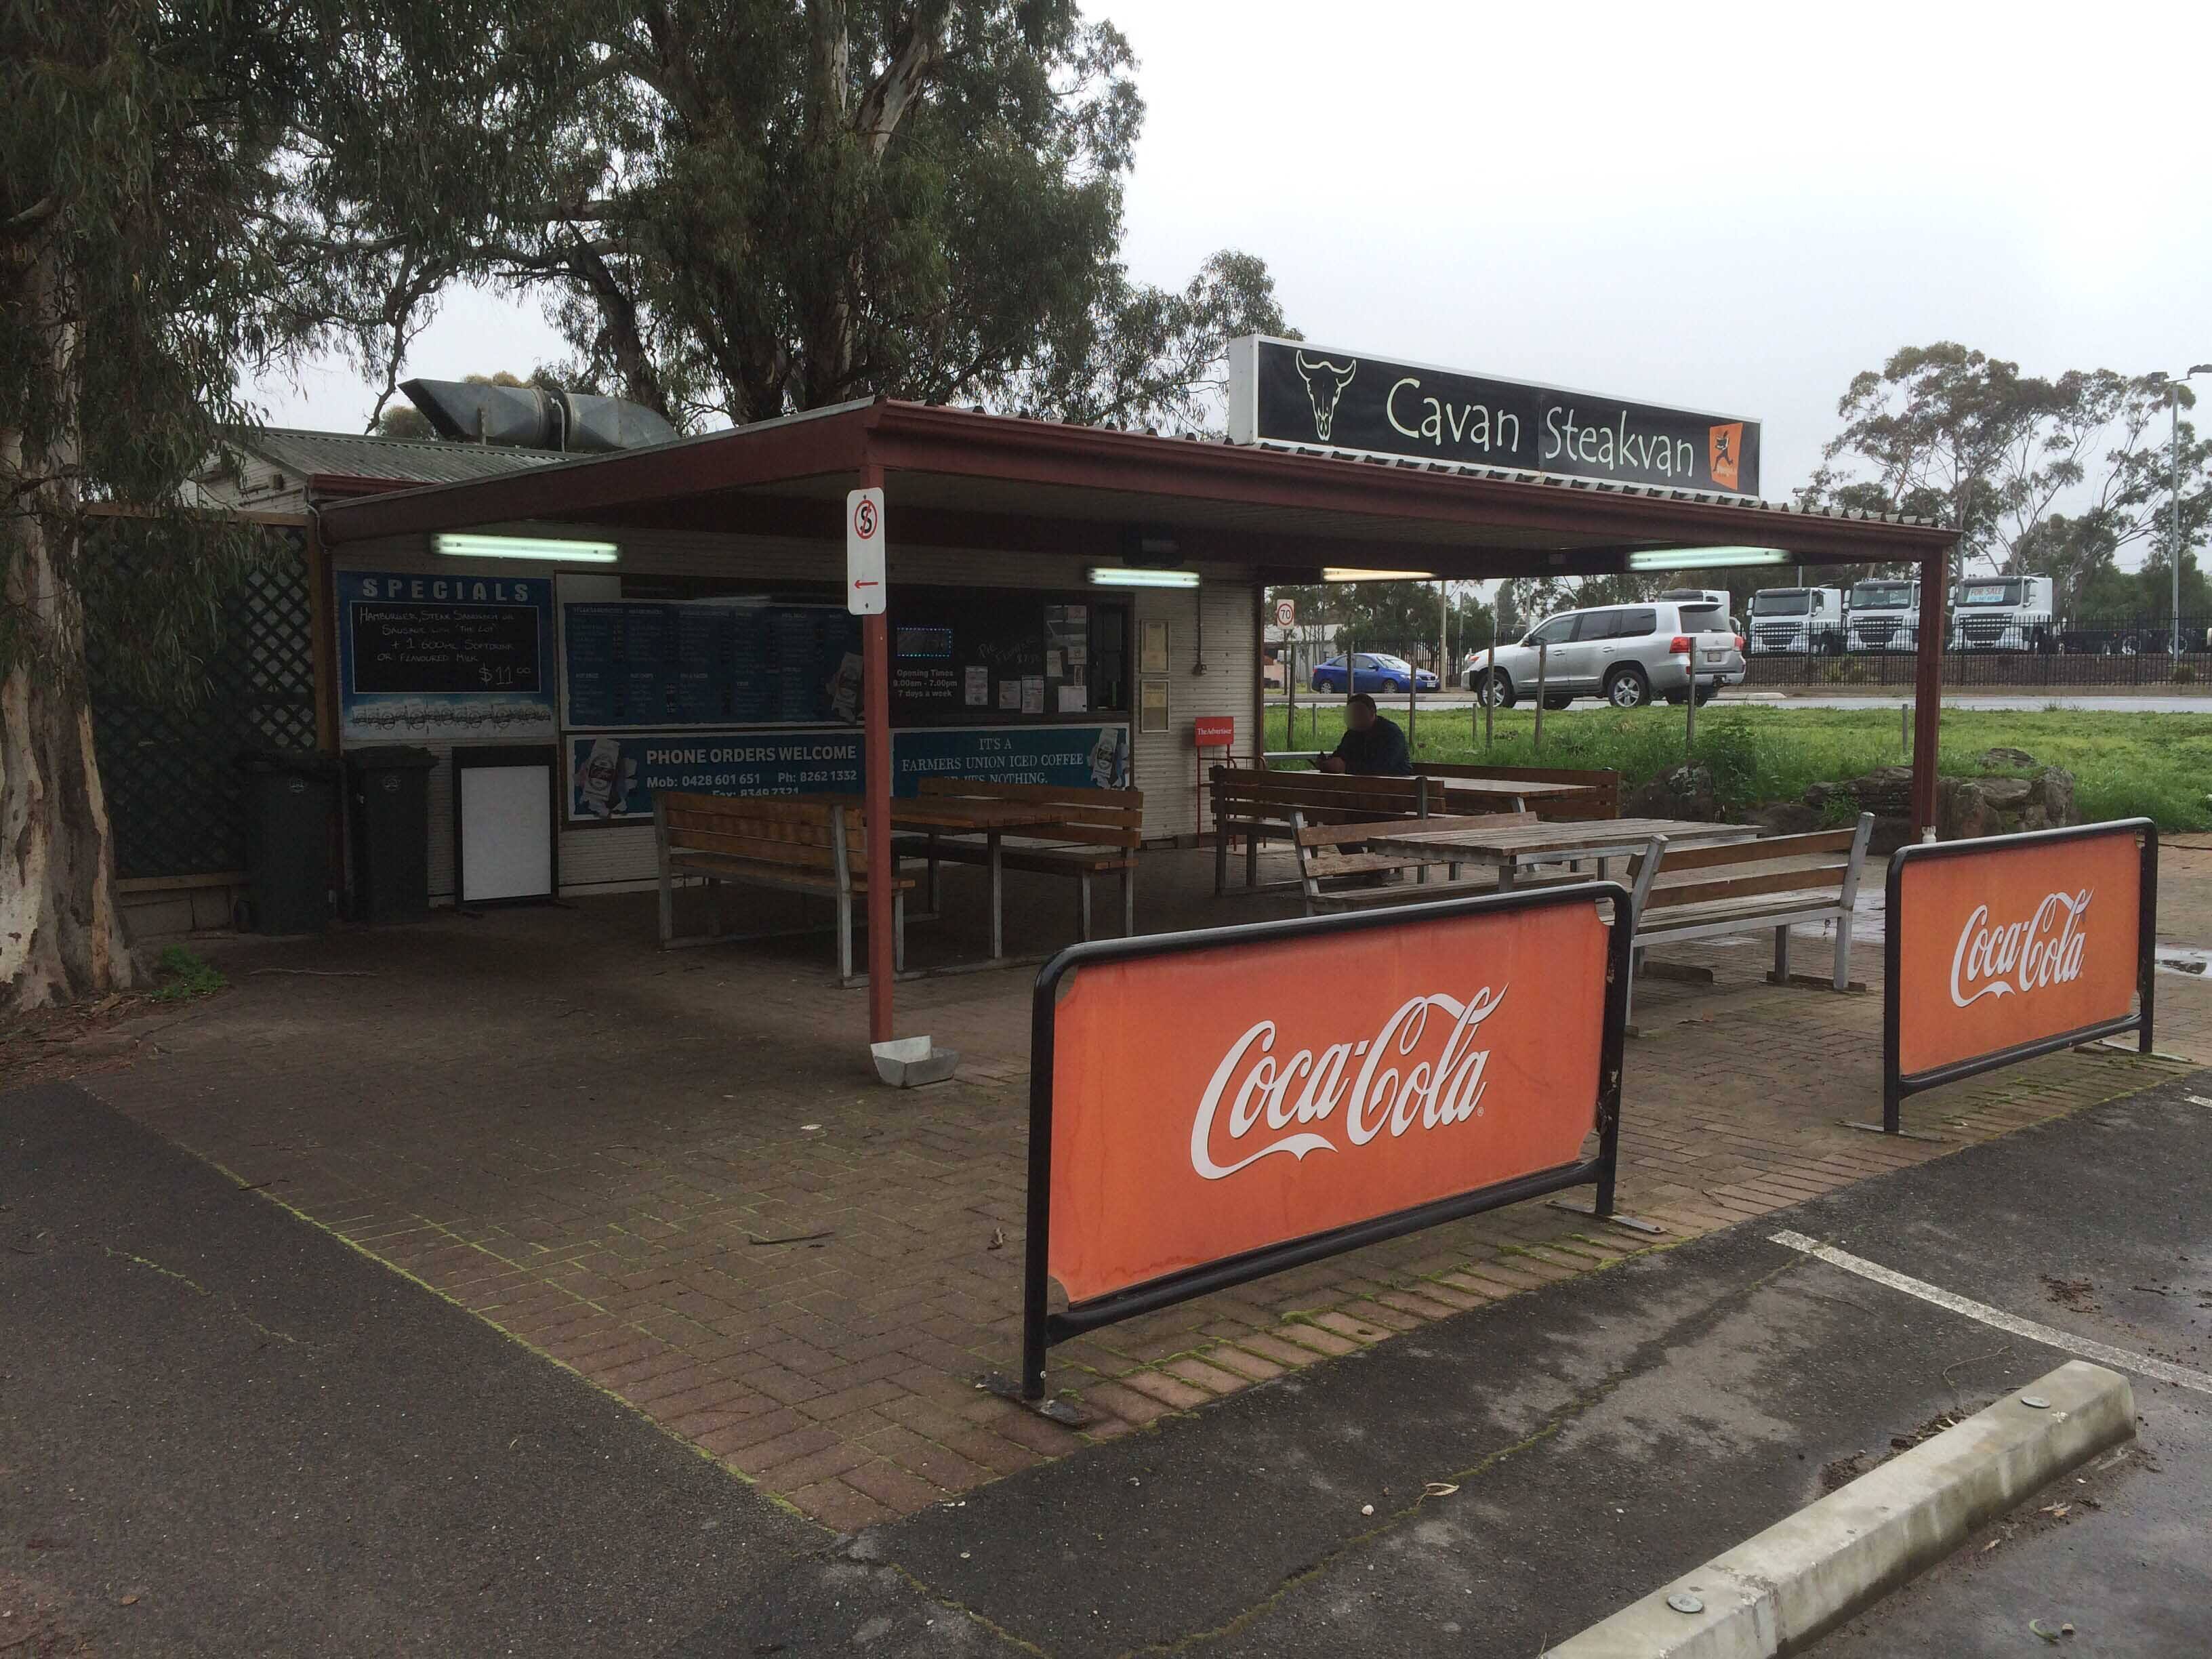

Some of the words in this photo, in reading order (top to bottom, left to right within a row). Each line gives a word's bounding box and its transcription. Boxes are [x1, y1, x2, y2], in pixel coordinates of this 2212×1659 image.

[1386, 377, 1519, 453] Cavan
[1544, 406, 1694, 477] Steakvan
[363, 578, 529, 602] SPECIALS
[1971, 588, 1984, 596] FOR
[1986, 587, 2003, 595] SALE
[1280, 609, 1291, 619] 70
[405, 638, 415, 649] 1
[377, 653, 392, 661] OR
[400, 653, 449, 662] FLAVOURED
[457, 653, 478, 662] MILK
[897, 669, 928, 678] Opening
[930, 669, 954, 677] Times
[905, 690, 923, 698] days
[931, 689, 953, 697] week
[979, 738, 1000, 750] IT'S
[1004, 737, 1012, 750] A
[647, 749, 706, 764] PHONE
[710, 747, 775, 763] ORDERS
[777, 745, 857, 761] WELCOME
[902, 758, 961, 771] FARMERS
[965, 756, 1005, 769] UNION
[1009, 755, 1038, 767] ICED
[1041, 753, 1084, 766] COFFEE
[647, 776, 677, 787] Mob:
[682, 775, 712, 786] 0428
[715, 774, 736, 785] 601
[739, 773, 760, 784] 651
[778, 772, 796, 782] Ph:
[800, 771, 827, 782] 8262
[830, 770, 857, 781] 1332
[987, 772, 1048, 785] NOTHING.
[1950, 886, 2094, 1008] Coca-Cola
[1191, 981, 1509, 1180] Coca-Cola
